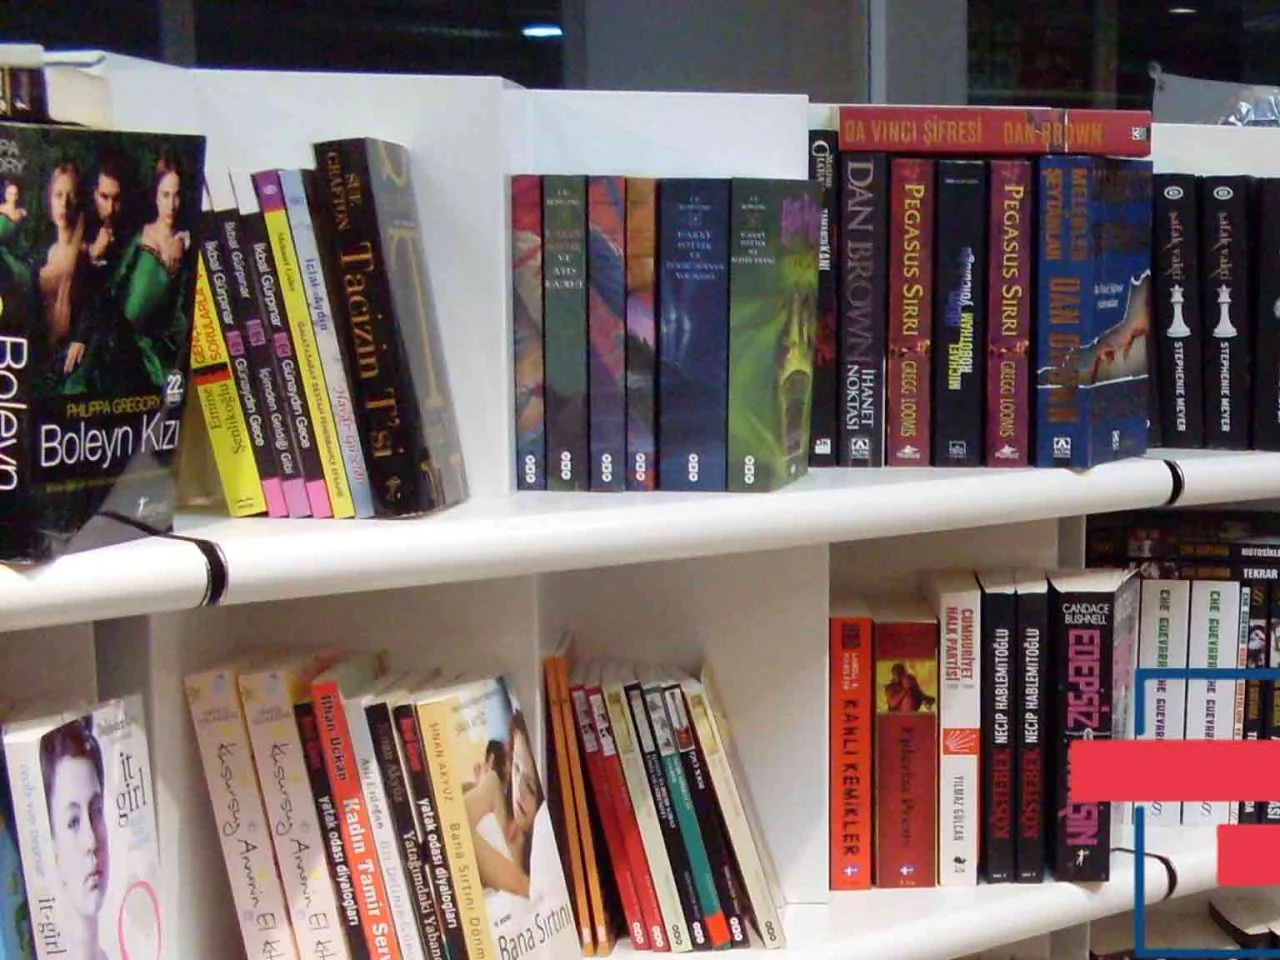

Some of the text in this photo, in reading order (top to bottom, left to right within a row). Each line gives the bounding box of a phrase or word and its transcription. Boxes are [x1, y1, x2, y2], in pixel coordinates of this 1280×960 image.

[846, 159, 874, 231] DAN
[903, 184, 926, 279] PEGASUS
[1003, 184, 1026, 280] PEGASUS
[1173, 341, 1187, 433] STEPHENIE MEYER
[1219, 341, 1233, 433] STEPHENIE MEYER
[40, 421, 134, 470] Boleyn
[1243, 567, 1279, 580] TEKRAR
[1062, 602, 1110, 616] CANDACE
[1064, 613, 1107, 626] BUSHNELL
[317, 796, 337, 830] yatak
[416, 797, 435, 830] yatak
[426, 832, 443, 864] odası
[343, 797, 365, 854] Kadın
[358, 858, 381, 917] Tamir
[535, 903, 572, 947] Sırtını
